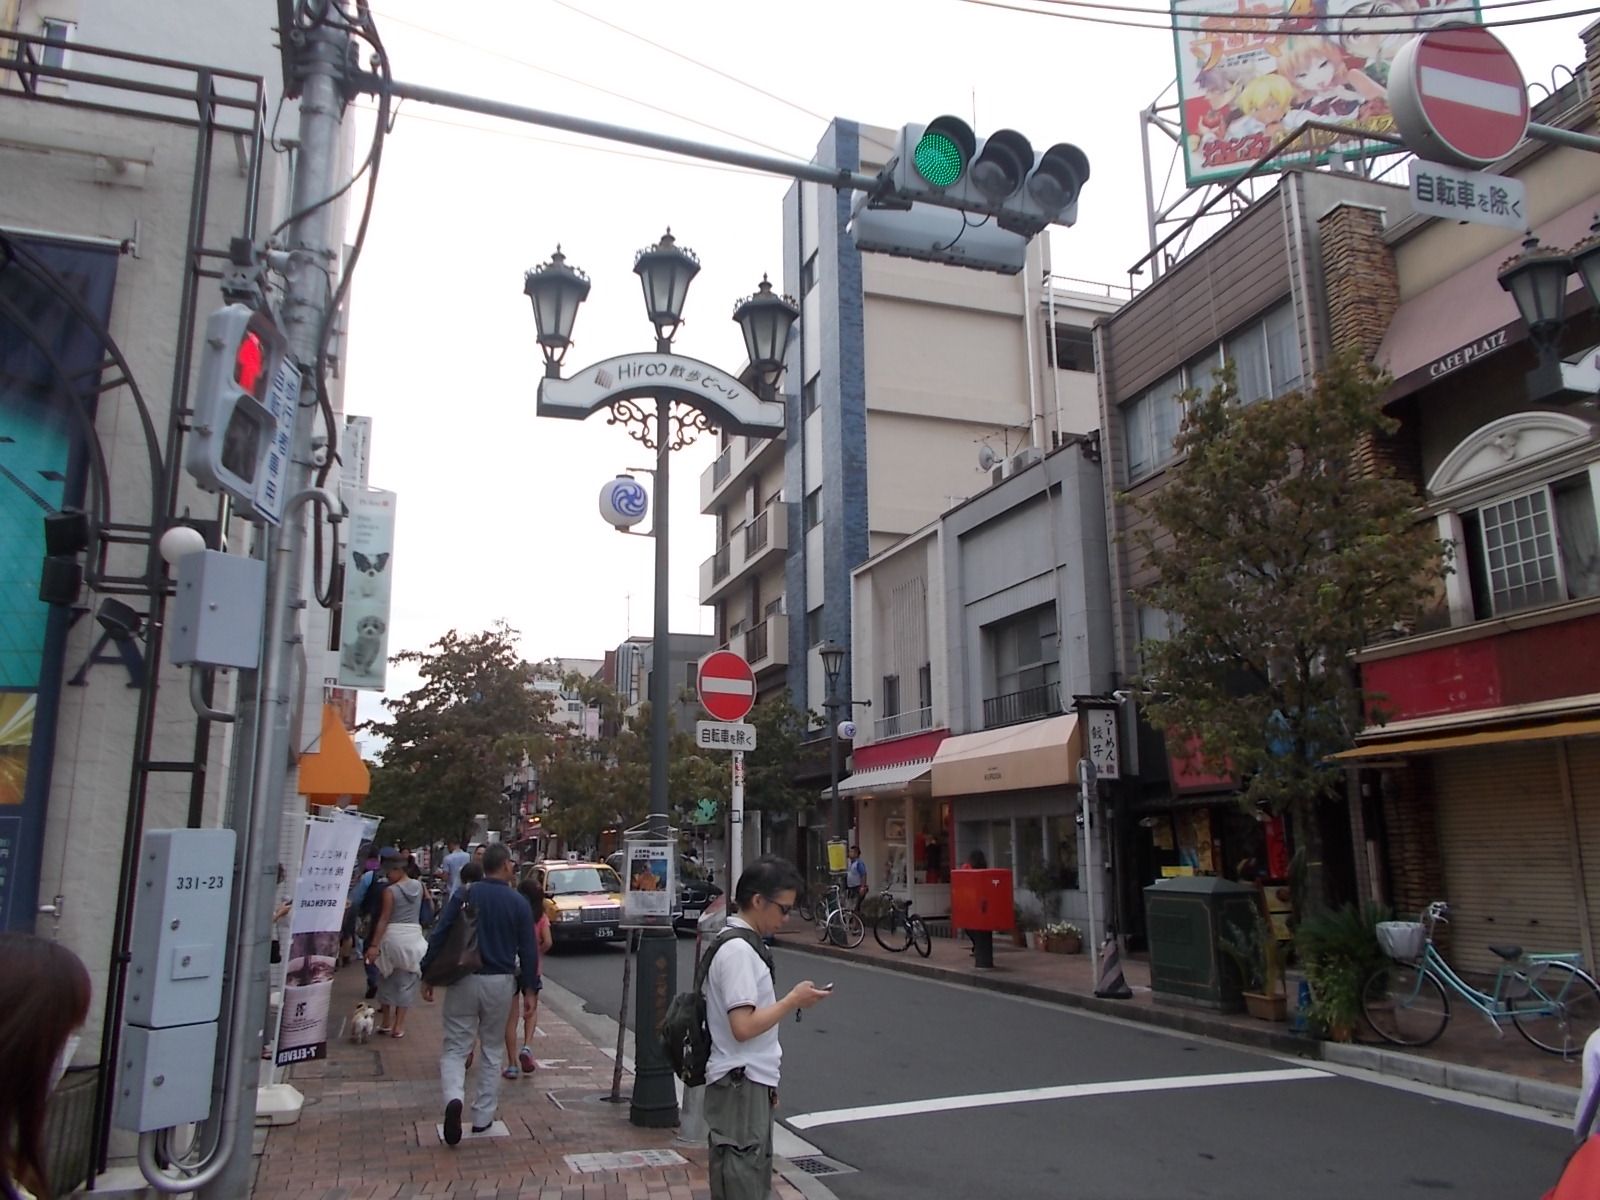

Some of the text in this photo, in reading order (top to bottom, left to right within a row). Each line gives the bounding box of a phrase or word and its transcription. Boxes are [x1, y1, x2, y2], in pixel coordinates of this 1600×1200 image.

[1415, 171, 1523, 220] 自転車を除く
[1429, 330, 1508, 377] CAFE PLATZ
[701, 727, 753, 746] 自転車を除く
[1092, 725, 1104, 758] 餃子
[1104, 713, 1116, 761] らーめん
[176, 876, 224, 890] 331-23
